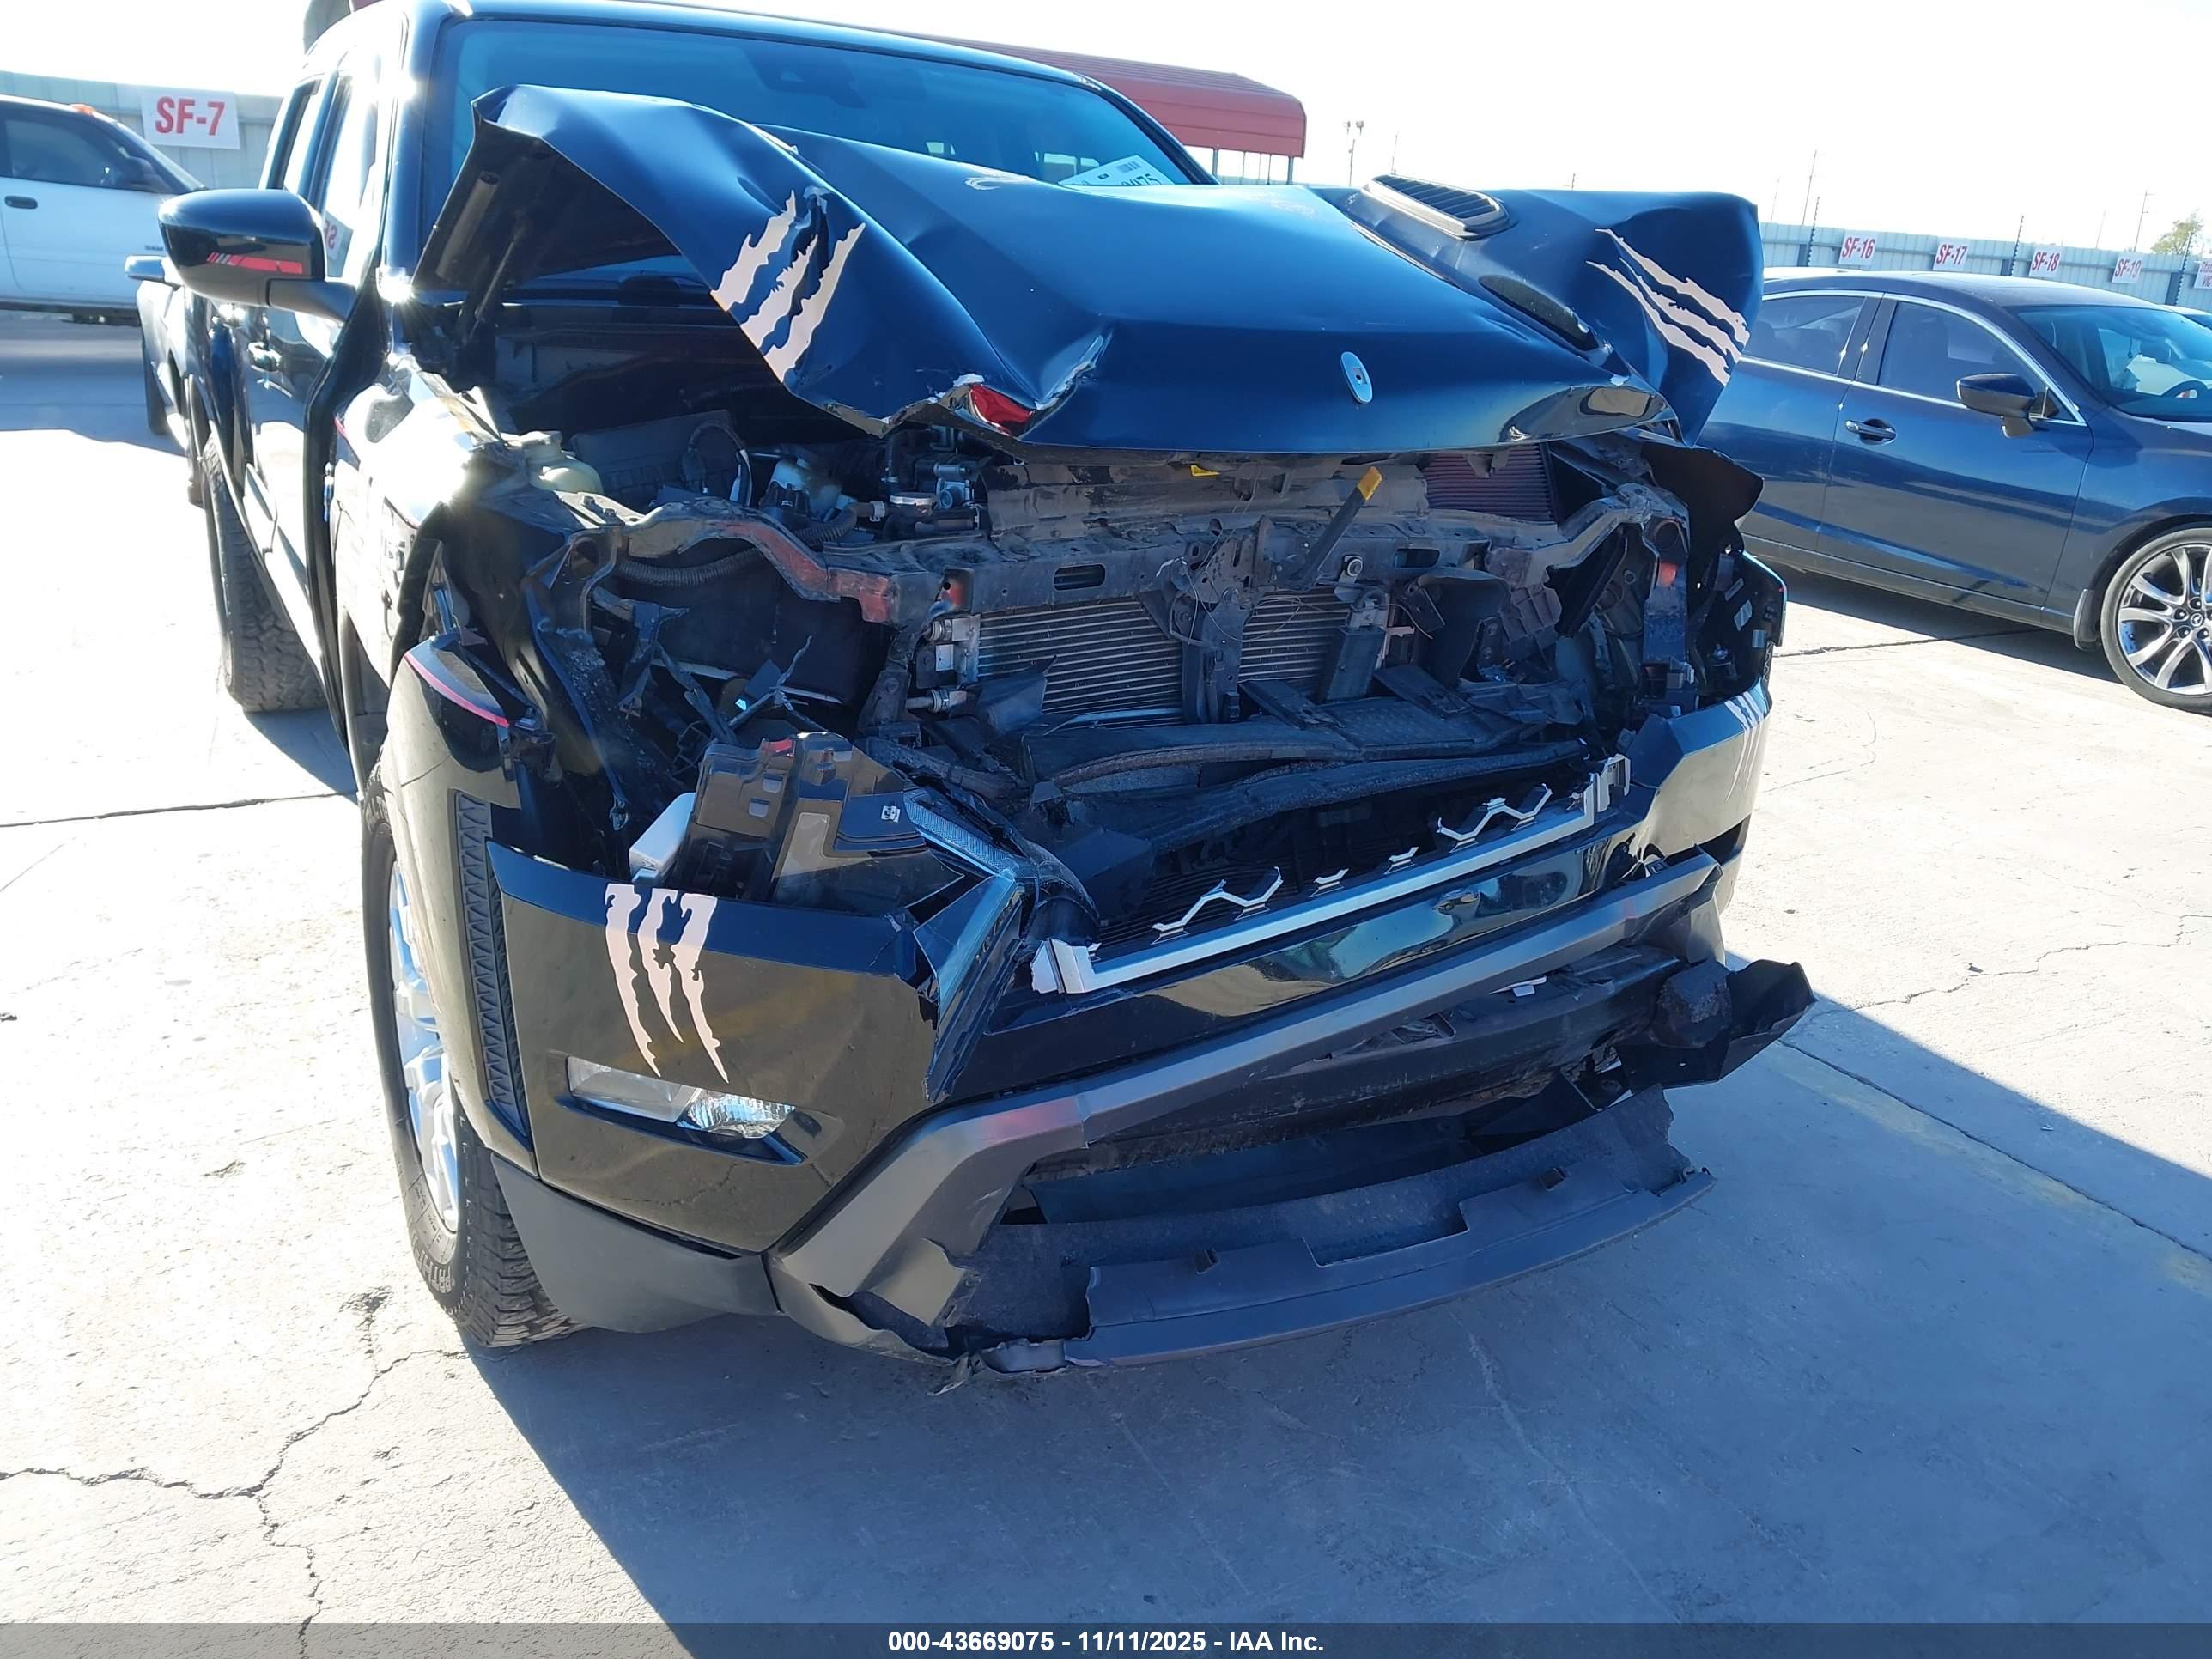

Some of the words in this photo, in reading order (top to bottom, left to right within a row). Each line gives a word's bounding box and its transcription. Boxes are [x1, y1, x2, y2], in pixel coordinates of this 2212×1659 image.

[155, 96, 225, 136] SF-7
[1842, 236, 1876, 259] SF-16
[1936, 243, 1969, 265] SF-17
[2032, 251, 2061, 272] SF-18
[2114, 258, 2142, 279] SF-19
